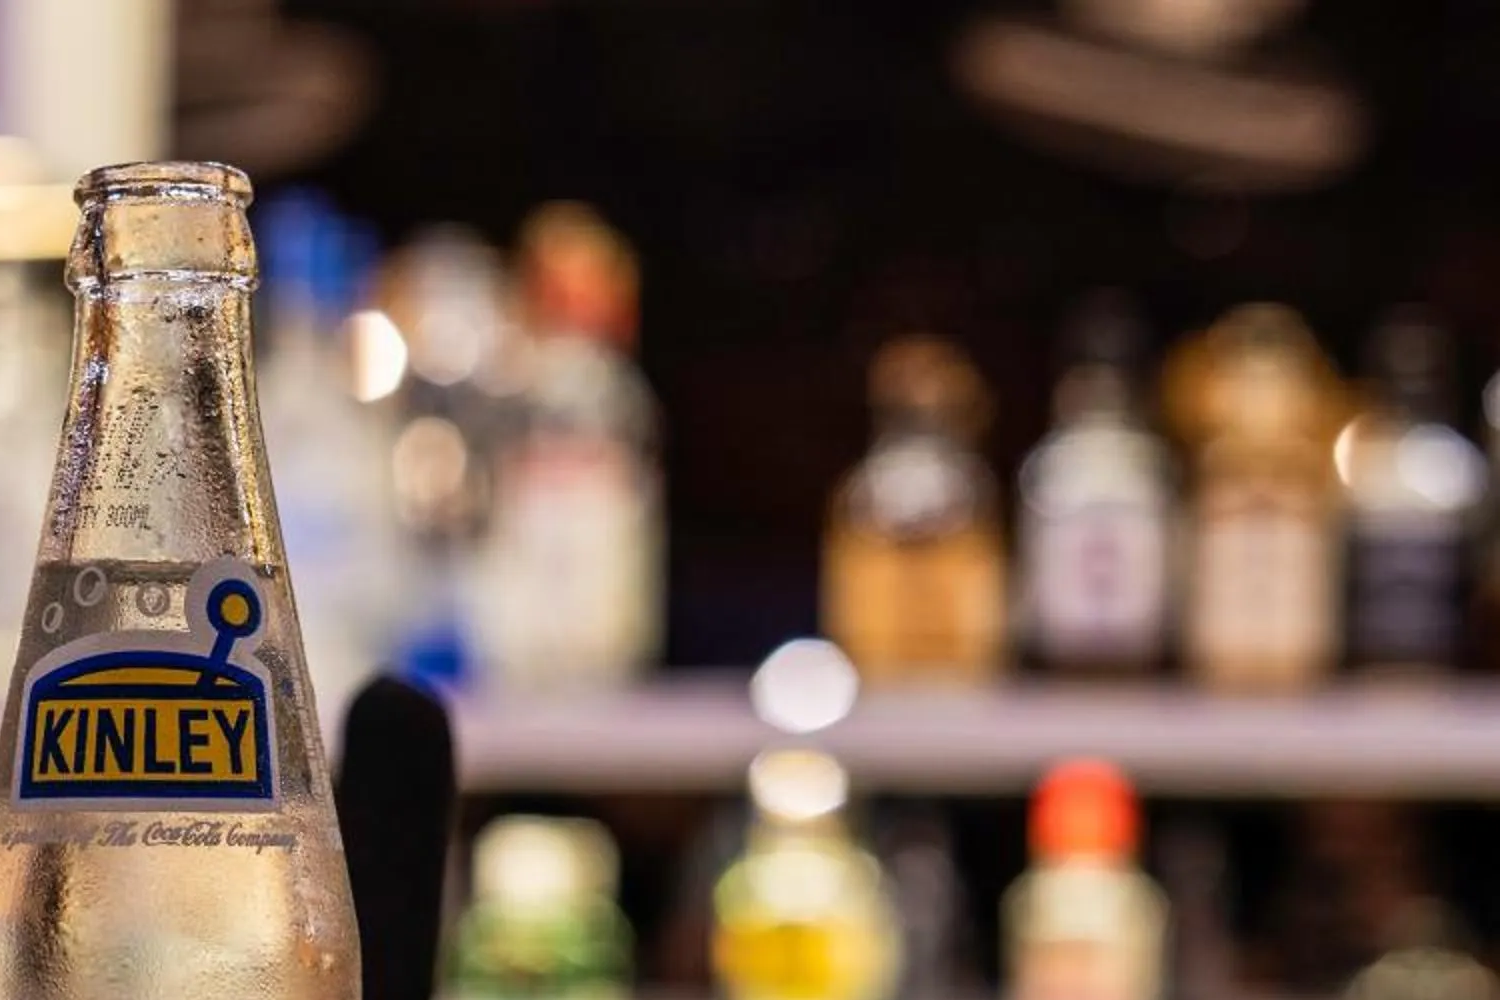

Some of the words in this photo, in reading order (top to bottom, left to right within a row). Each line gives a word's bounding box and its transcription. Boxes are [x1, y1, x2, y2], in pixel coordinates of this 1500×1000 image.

[38, 708, 249, 775] KINLEY
[98, 820, 139, 847] The
[226, 822, 298, 855] Company
